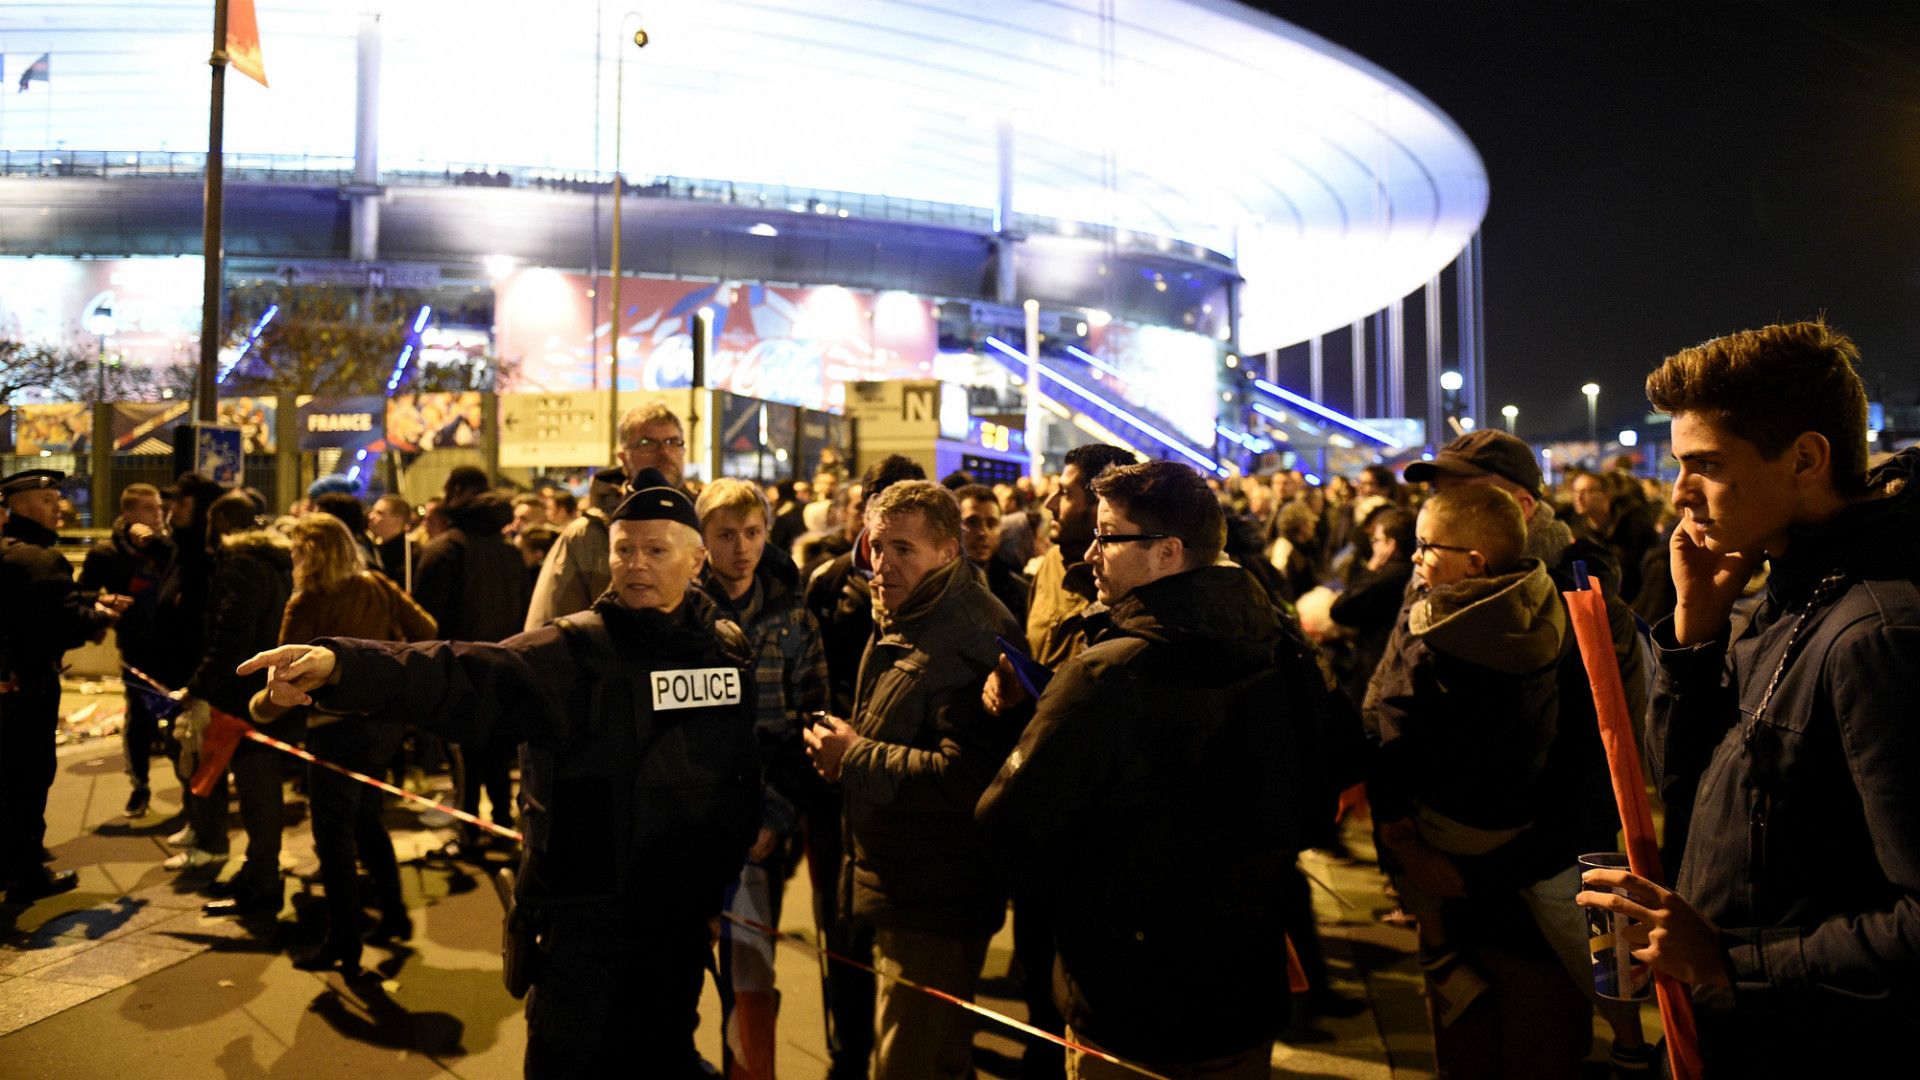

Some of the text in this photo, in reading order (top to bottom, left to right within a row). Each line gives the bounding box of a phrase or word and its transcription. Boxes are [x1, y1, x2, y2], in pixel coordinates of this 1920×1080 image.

[905, 390, 934, 421] N
[308, 413, 372, 432] FRANCE
[656, 672, 737, 704] POLICE
